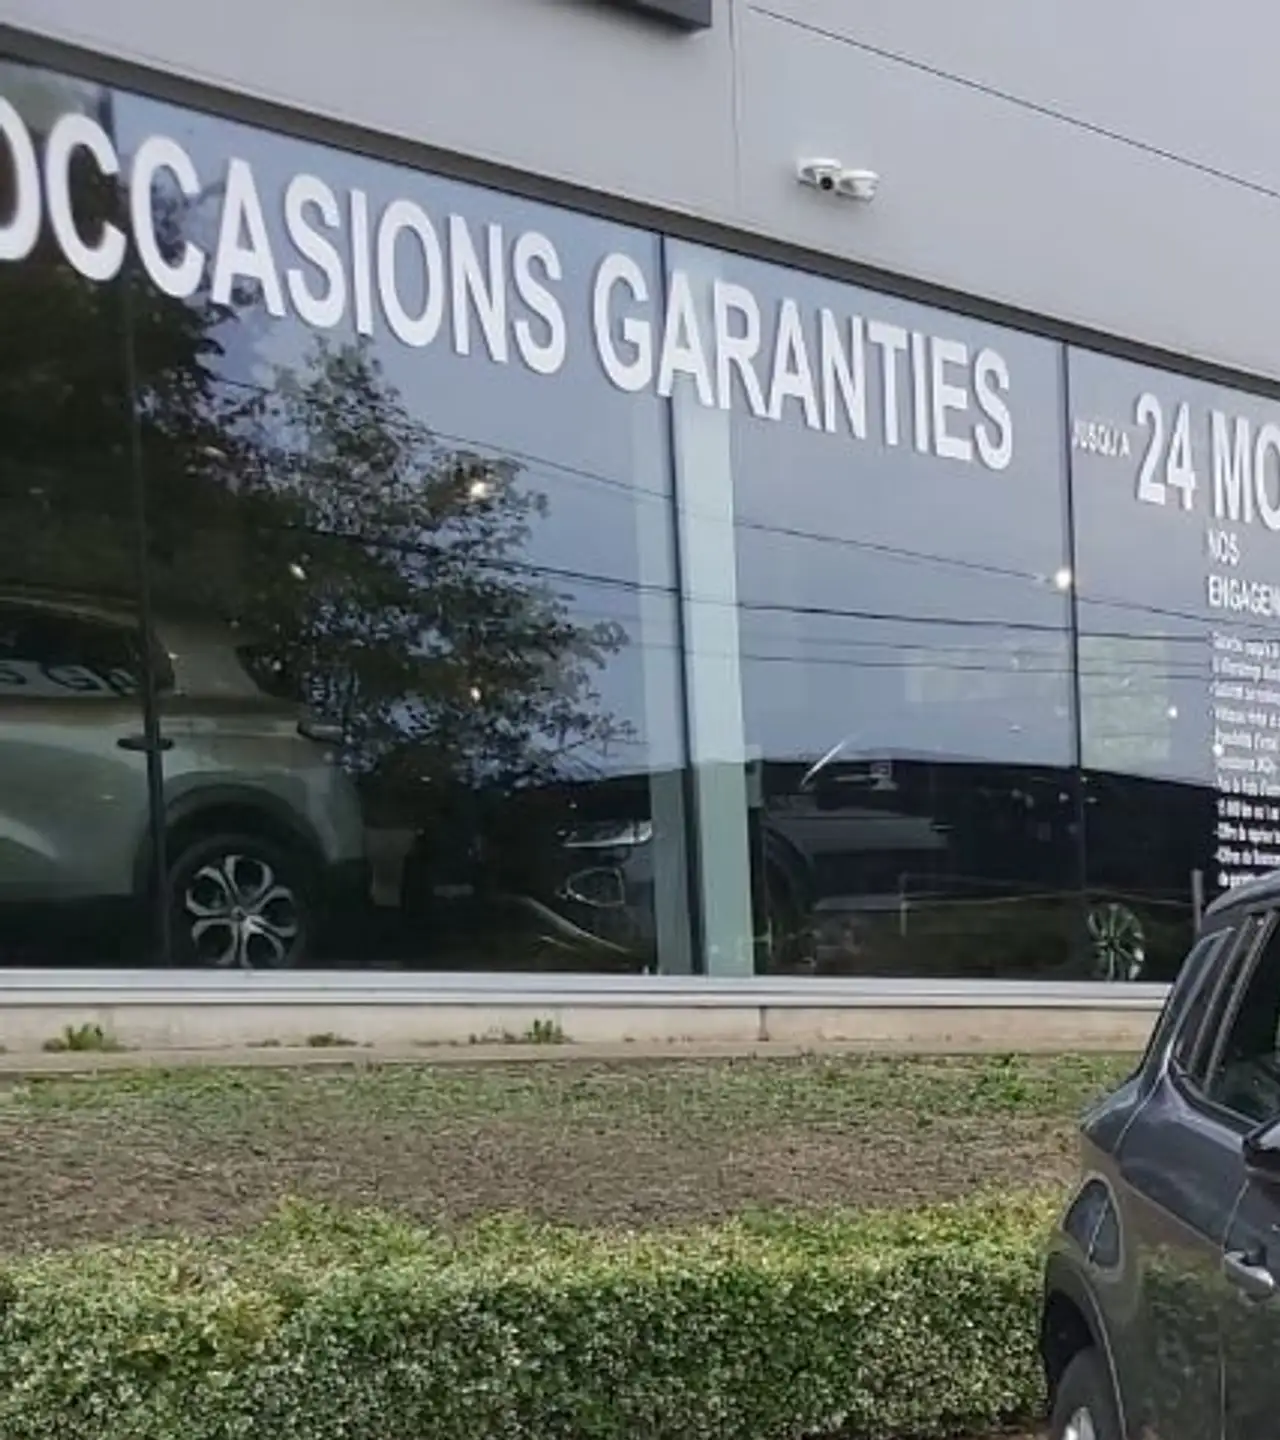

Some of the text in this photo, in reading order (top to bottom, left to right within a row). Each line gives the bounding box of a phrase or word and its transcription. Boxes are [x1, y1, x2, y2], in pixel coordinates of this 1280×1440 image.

[594, 253, 1014, 471] GARANTIES
[1136, 392, 1196, 512] 24
[1207, 530, 1241, 566] NOS
